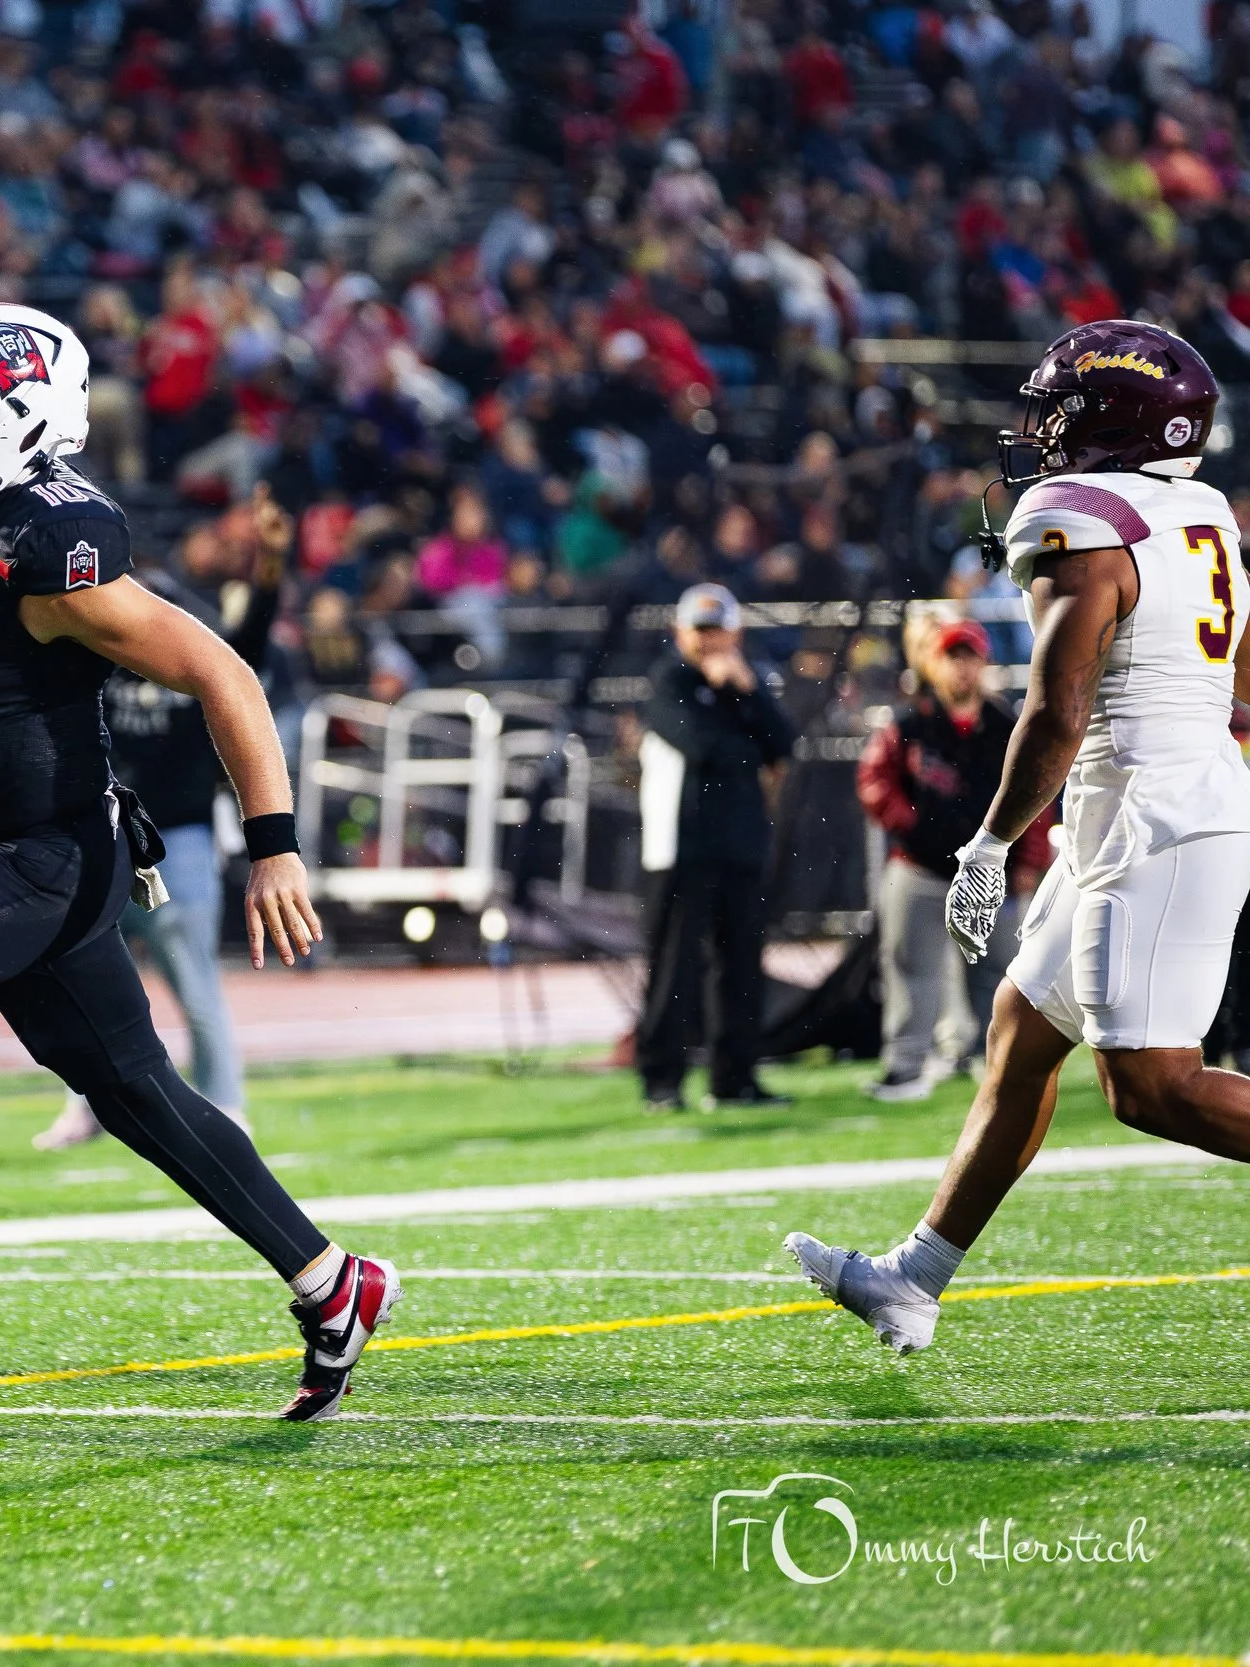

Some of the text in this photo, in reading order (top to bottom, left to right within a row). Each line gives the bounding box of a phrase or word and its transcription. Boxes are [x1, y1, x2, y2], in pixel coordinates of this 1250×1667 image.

[1075, 350, 1165, 379] Huskies
[1167, 422, 1189, 440] 75
[29, 481, 90, 507] 10
[1182, 525, 1236, 665] 3
